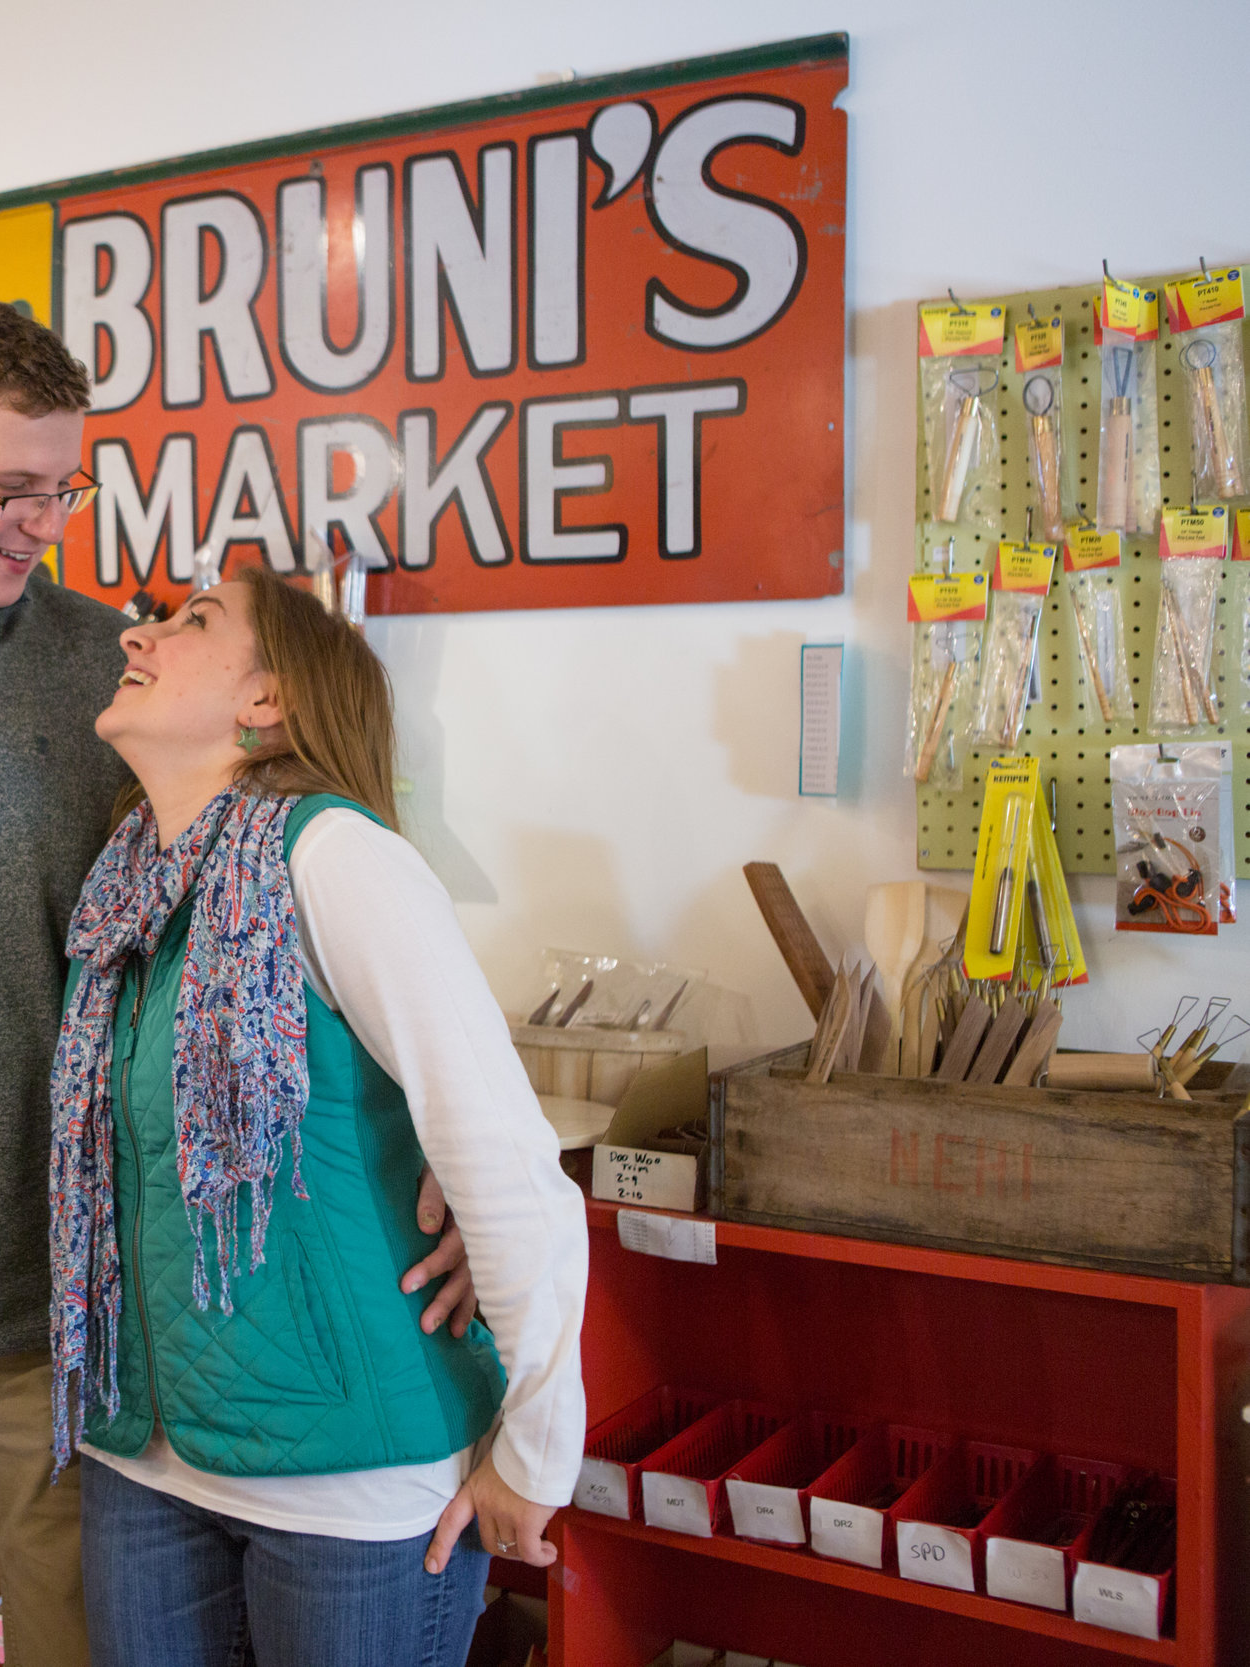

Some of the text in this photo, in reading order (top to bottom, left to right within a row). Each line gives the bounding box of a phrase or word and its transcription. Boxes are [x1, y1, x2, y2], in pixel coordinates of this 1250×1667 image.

[61, 92, 808, 417] BRUNI'S
[91, 378, 748, 588] MARKET
[1180, 518, 1205, 526] PTM50
[993, 775, 1030, 784] KEMPER
[889, 1128, 1033, 1202] NEHI
[618, 1188, 643, 1200] 2-10
[666, 1497, 685, 1507] MDT
[755, 1506, 774, 1516] DR4
[833, 1519, 853, 1529] DR2
[910, 1542, 946, 1562] SPD
[1098, 1587, 1124, 1602] WLS
